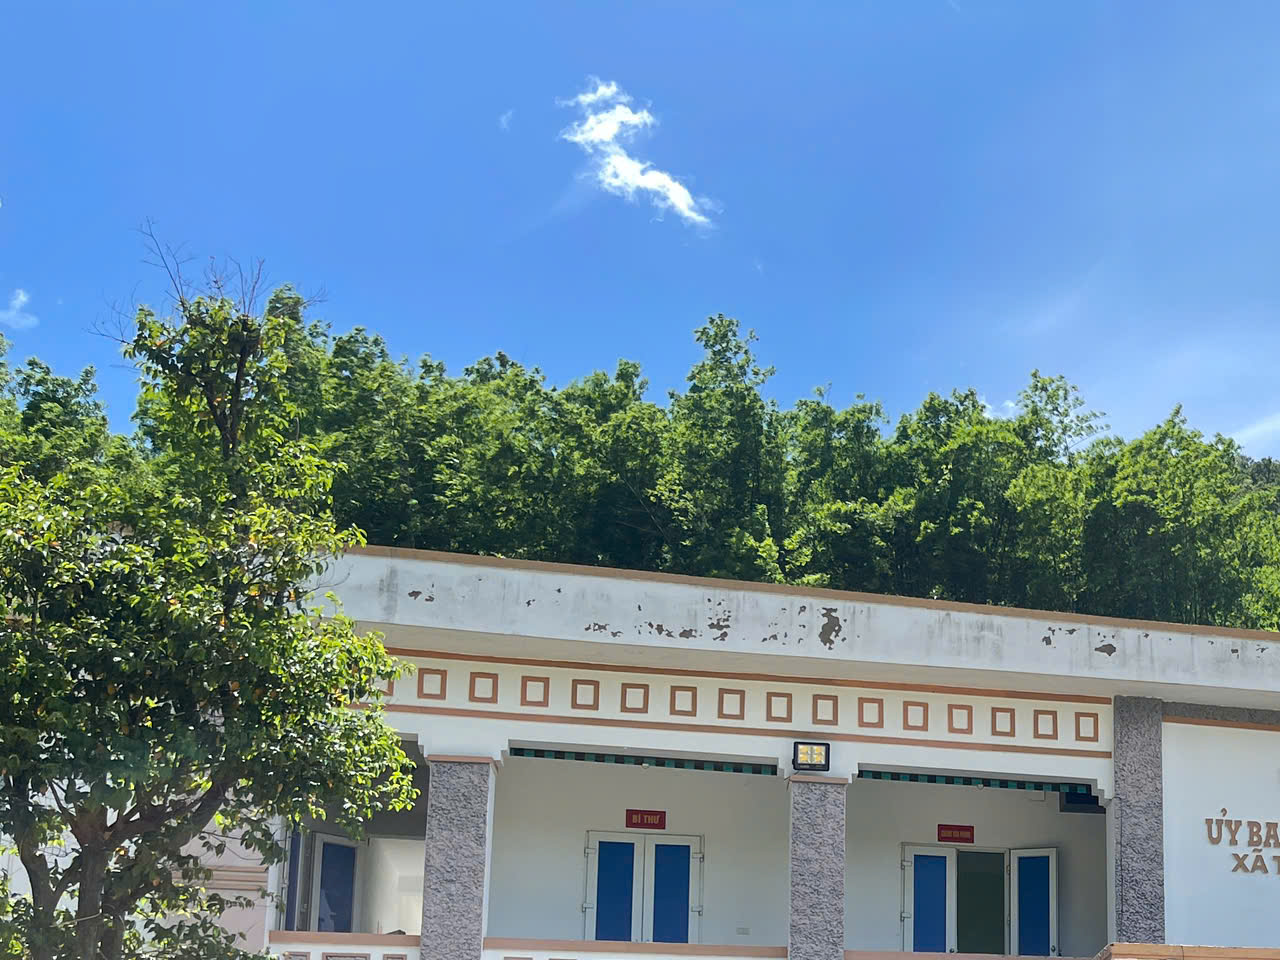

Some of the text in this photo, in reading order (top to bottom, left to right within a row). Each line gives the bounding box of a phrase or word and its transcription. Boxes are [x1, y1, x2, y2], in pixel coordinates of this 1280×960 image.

[644, 814, 661, 824] THƯ
[1205, 807, 1242, 846] ỦY
[1231, 848, 1268, 874] XÃ
